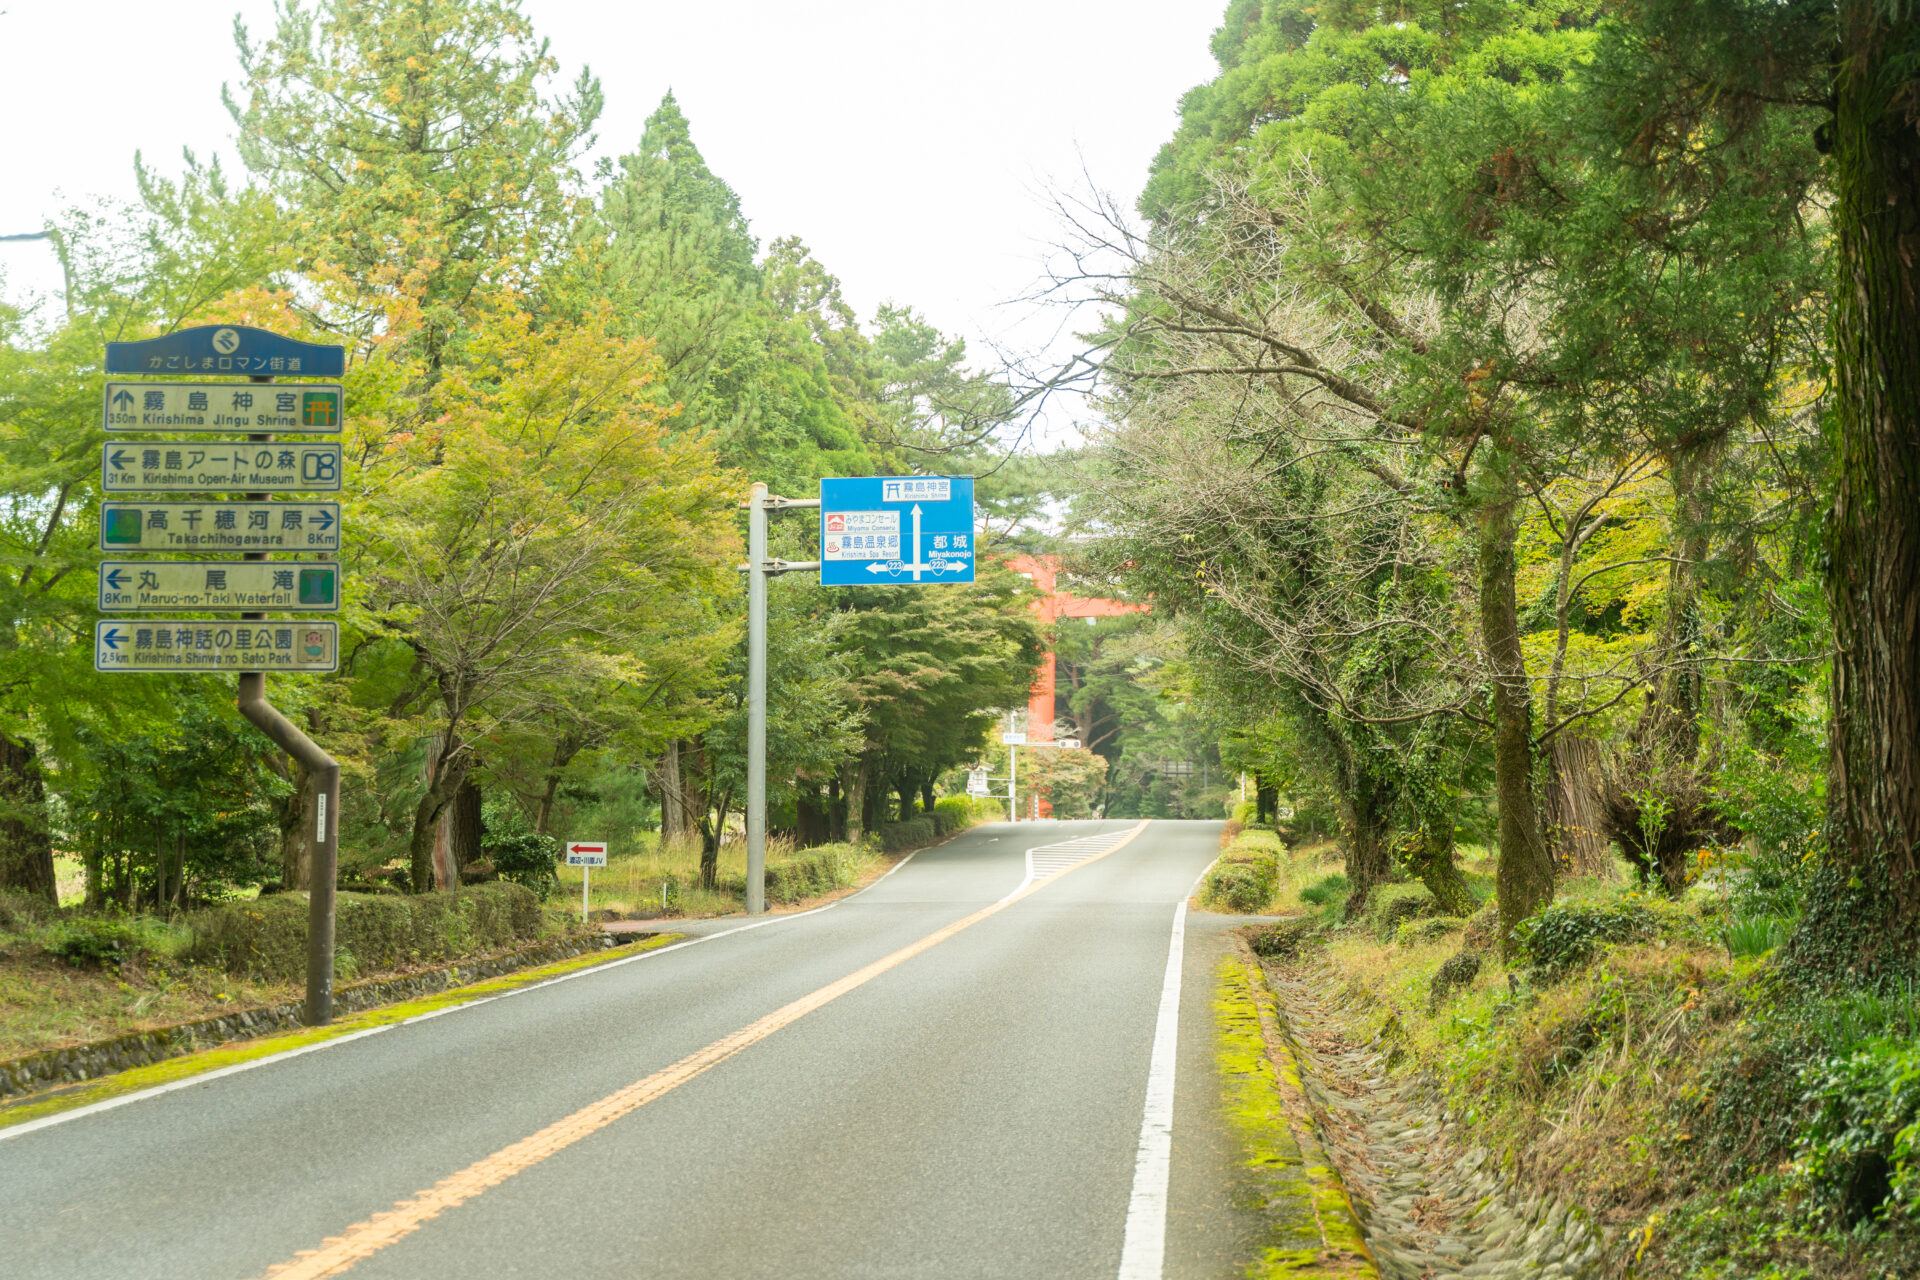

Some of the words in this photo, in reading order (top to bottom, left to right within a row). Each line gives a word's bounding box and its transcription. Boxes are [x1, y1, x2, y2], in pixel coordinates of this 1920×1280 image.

[149, 356, 302, 371] かごしまロマン街道
[143, 390, 297, 412] 霧島神宮
[109, 414, 137, 424] 350m
[143, 413, 204, 424] Kirishima
[213, 414, 249, 426] Jingu
[257, 415, 296, 426] Shrine
[142, 449, 296, 470] 霧島アートの森
[143, 473, 194, 484] Kirishima
[198, 473, 246, 486] Open-Air
[249, 474, 294, 484] Museum
[147, 510, 303, 530] 高千穂河原
[845, 514, 896, 524] みやまコンセール
[167, 533, 282, 547] Takachihogawara
[307, 533, 335, 544] 8Km
[842, 535, 898, 549] 霧島温泉郷
[933, 535, 967, 549] 都城
[928, 550, 972, 559] Miyakonojo
[888, 561, 901, 569] 223
[931, 561, 945, 569] 223
[137, 569, 294, 590] 丸尾滝
[104, 593, 132, 604] 8Km
[140, 593, 230, 604] Maruo-no-Taki
[234, 593, 291, 604] Waterfall
[135, 629, 292, 650] 霧島神話の里公園
[134, 652, 181, 664] Kirishima
[185, 653, 221, 664] Shinwa
[225, 655, 238, 664] no
[241, 653, 265, 664] Sato
[268, 653, 291, 664] Park
